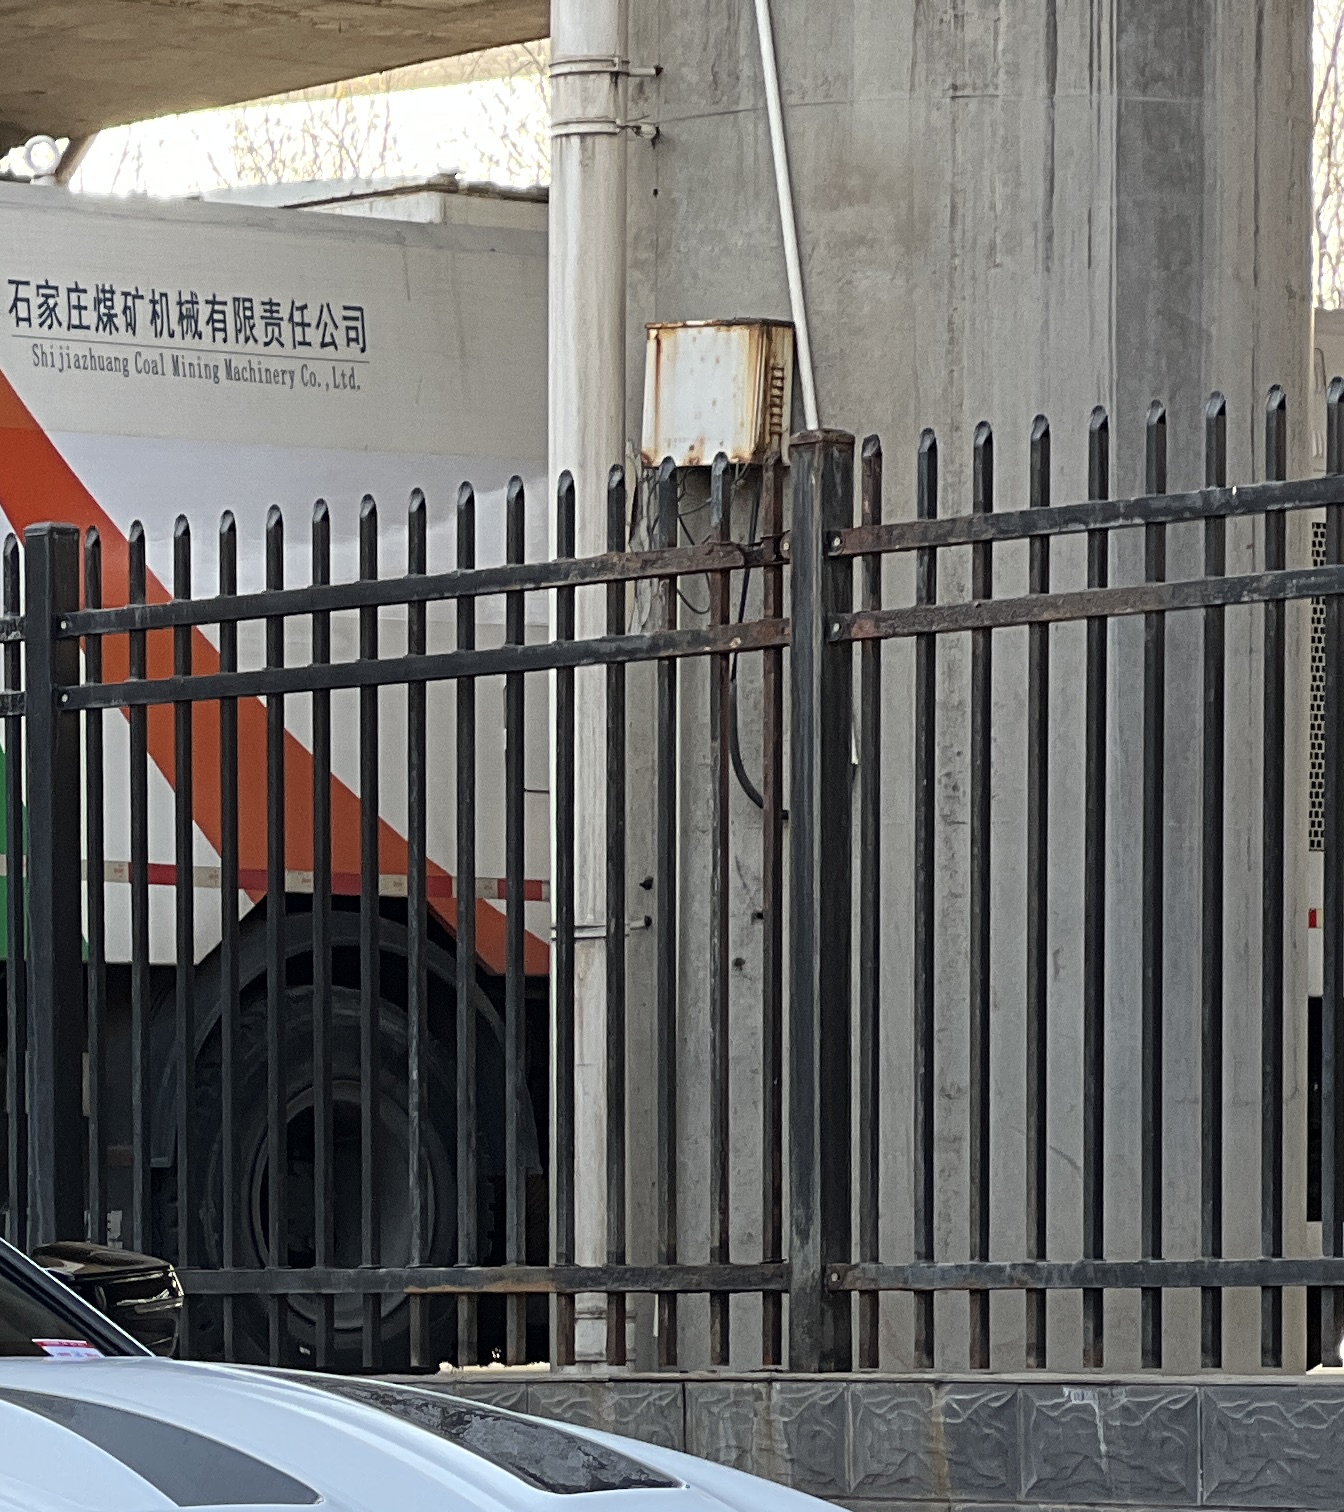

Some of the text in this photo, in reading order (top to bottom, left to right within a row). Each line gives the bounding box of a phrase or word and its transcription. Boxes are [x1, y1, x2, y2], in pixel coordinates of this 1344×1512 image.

[8, 279, 367, 354] 石家庄煤矿机械有限责任公司
[31, 343, 130, 378] Shijiazhuang
[134, 350, 167, 377] Coal
[171, 352, 220, 385] Mining
[223, 357, 296, 390] Machinery
